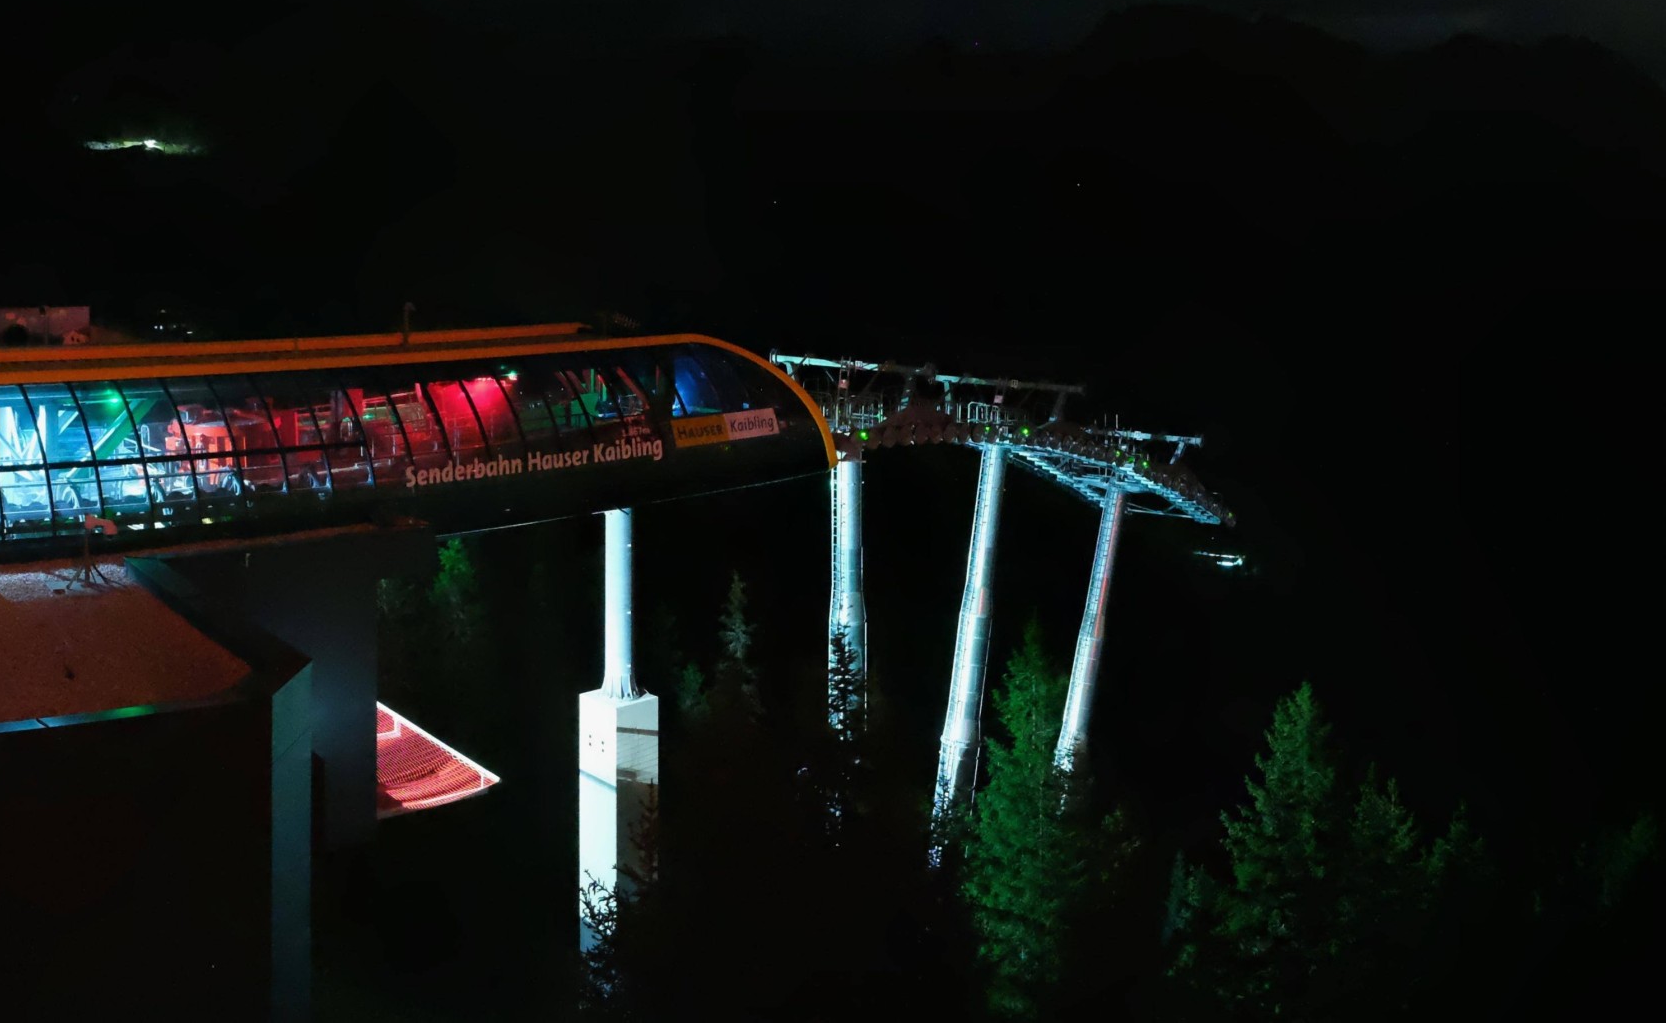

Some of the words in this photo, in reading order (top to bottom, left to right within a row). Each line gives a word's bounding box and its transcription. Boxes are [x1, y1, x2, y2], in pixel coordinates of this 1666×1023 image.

[677, 424, 723, 440] HAUSER
[730, 417, 774, 433] Kaibling
[405, 454, 523, 488] Senderbahn
[528, 448, 590, 472] Hauser
[593, 437, 663, 461] Kaibling
